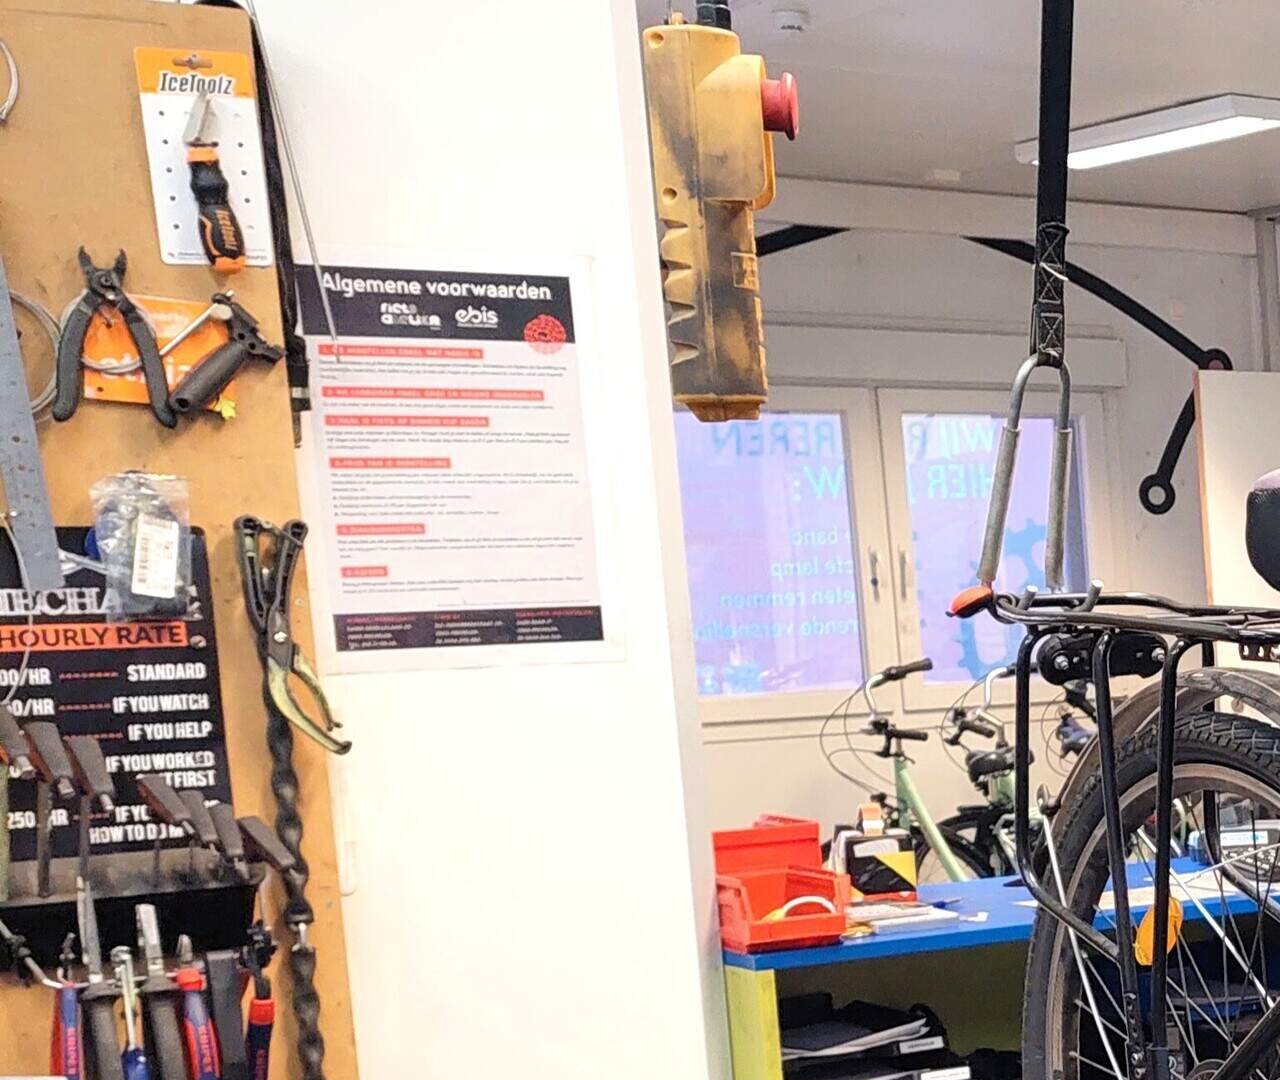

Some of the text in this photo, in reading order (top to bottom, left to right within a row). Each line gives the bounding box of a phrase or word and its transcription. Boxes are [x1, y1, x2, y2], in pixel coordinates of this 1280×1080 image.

[160, 72, 233, 95] IceToolz
[321, 272, 551, 300] Algemene voorwaarden
[0, 625, 184, 647] HOURLY RATE
[127, 662, 207, 682] STANDARD
[7, 694, 210, 717] 0/HR IF YOU WATCH
[128, 721, 213, 742] IF YOU HELP
[105, 751, 215, 773] IF YOU WORKED
[174, 770, 217, 789] FIRST
[115, 805, 130, 824] IF
[88, 825, 124, 845] HOW
[124, 824, 145, 842] TO
